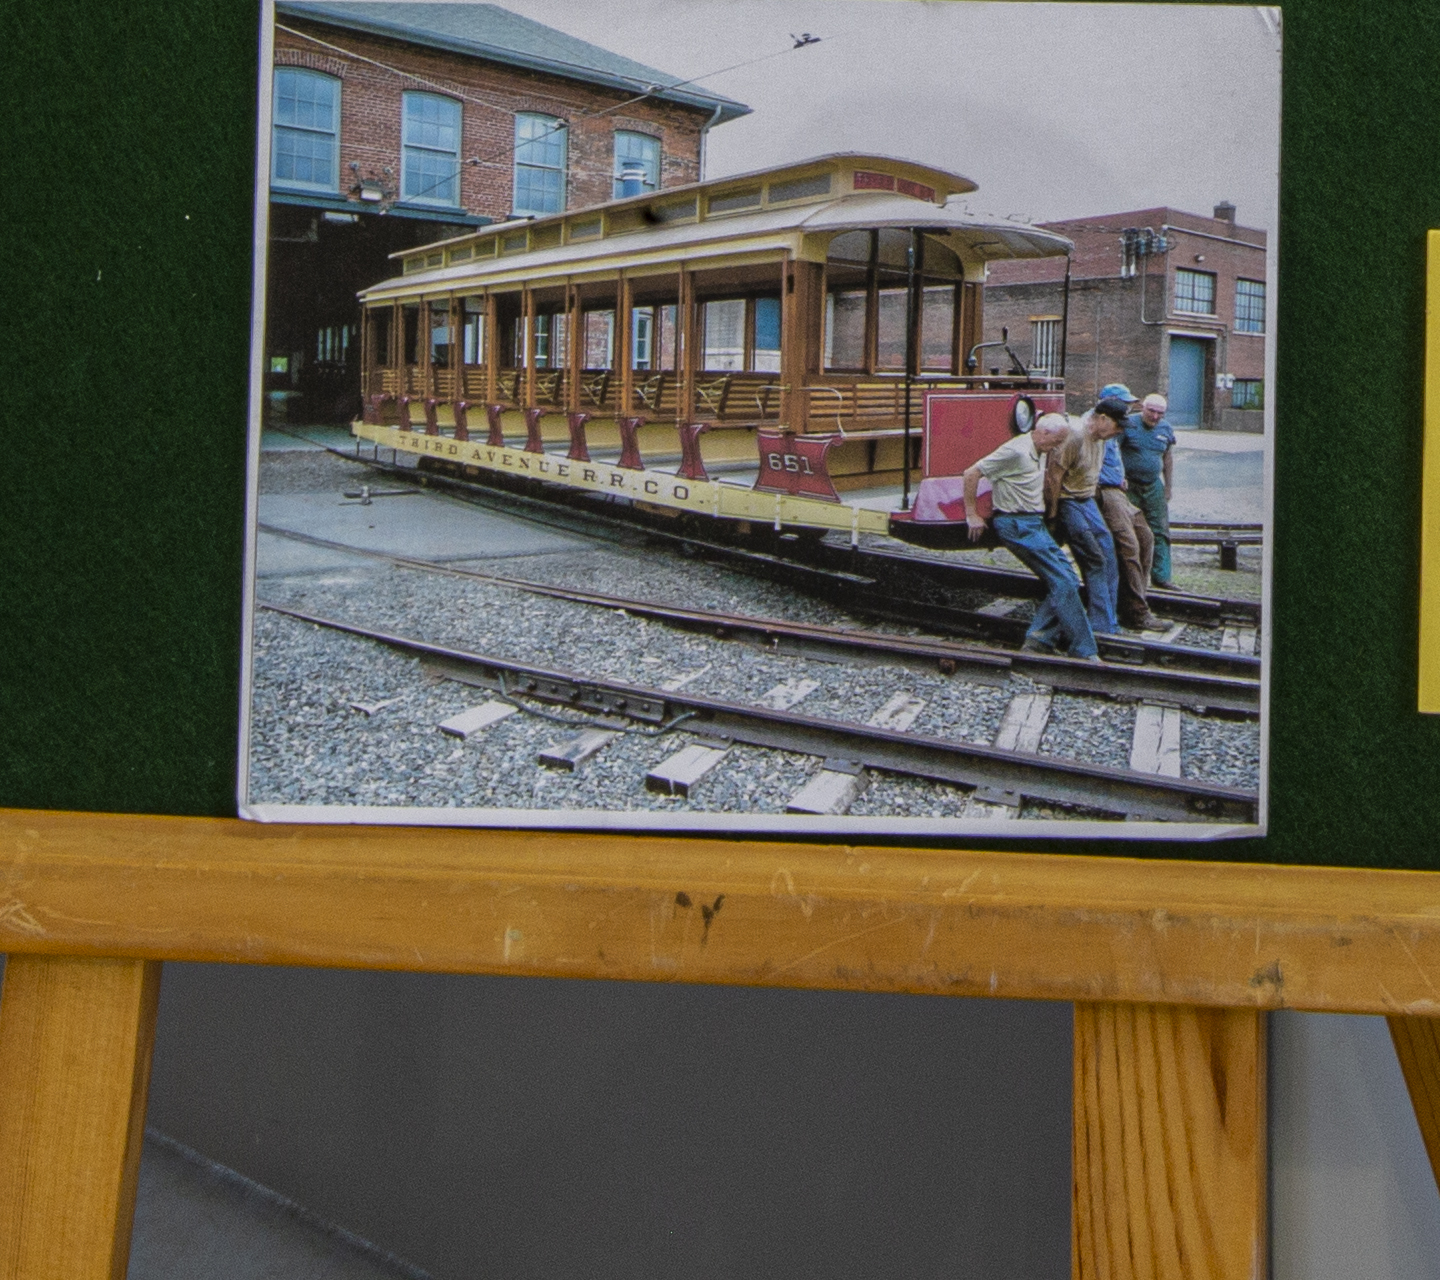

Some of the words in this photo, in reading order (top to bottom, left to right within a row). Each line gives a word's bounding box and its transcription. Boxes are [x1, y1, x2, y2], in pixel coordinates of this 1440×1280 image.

[399, 435, 458, 455] THIRD
[471, 448, 570, 478] AVENUE
[767, 452, 815, 476] 651
